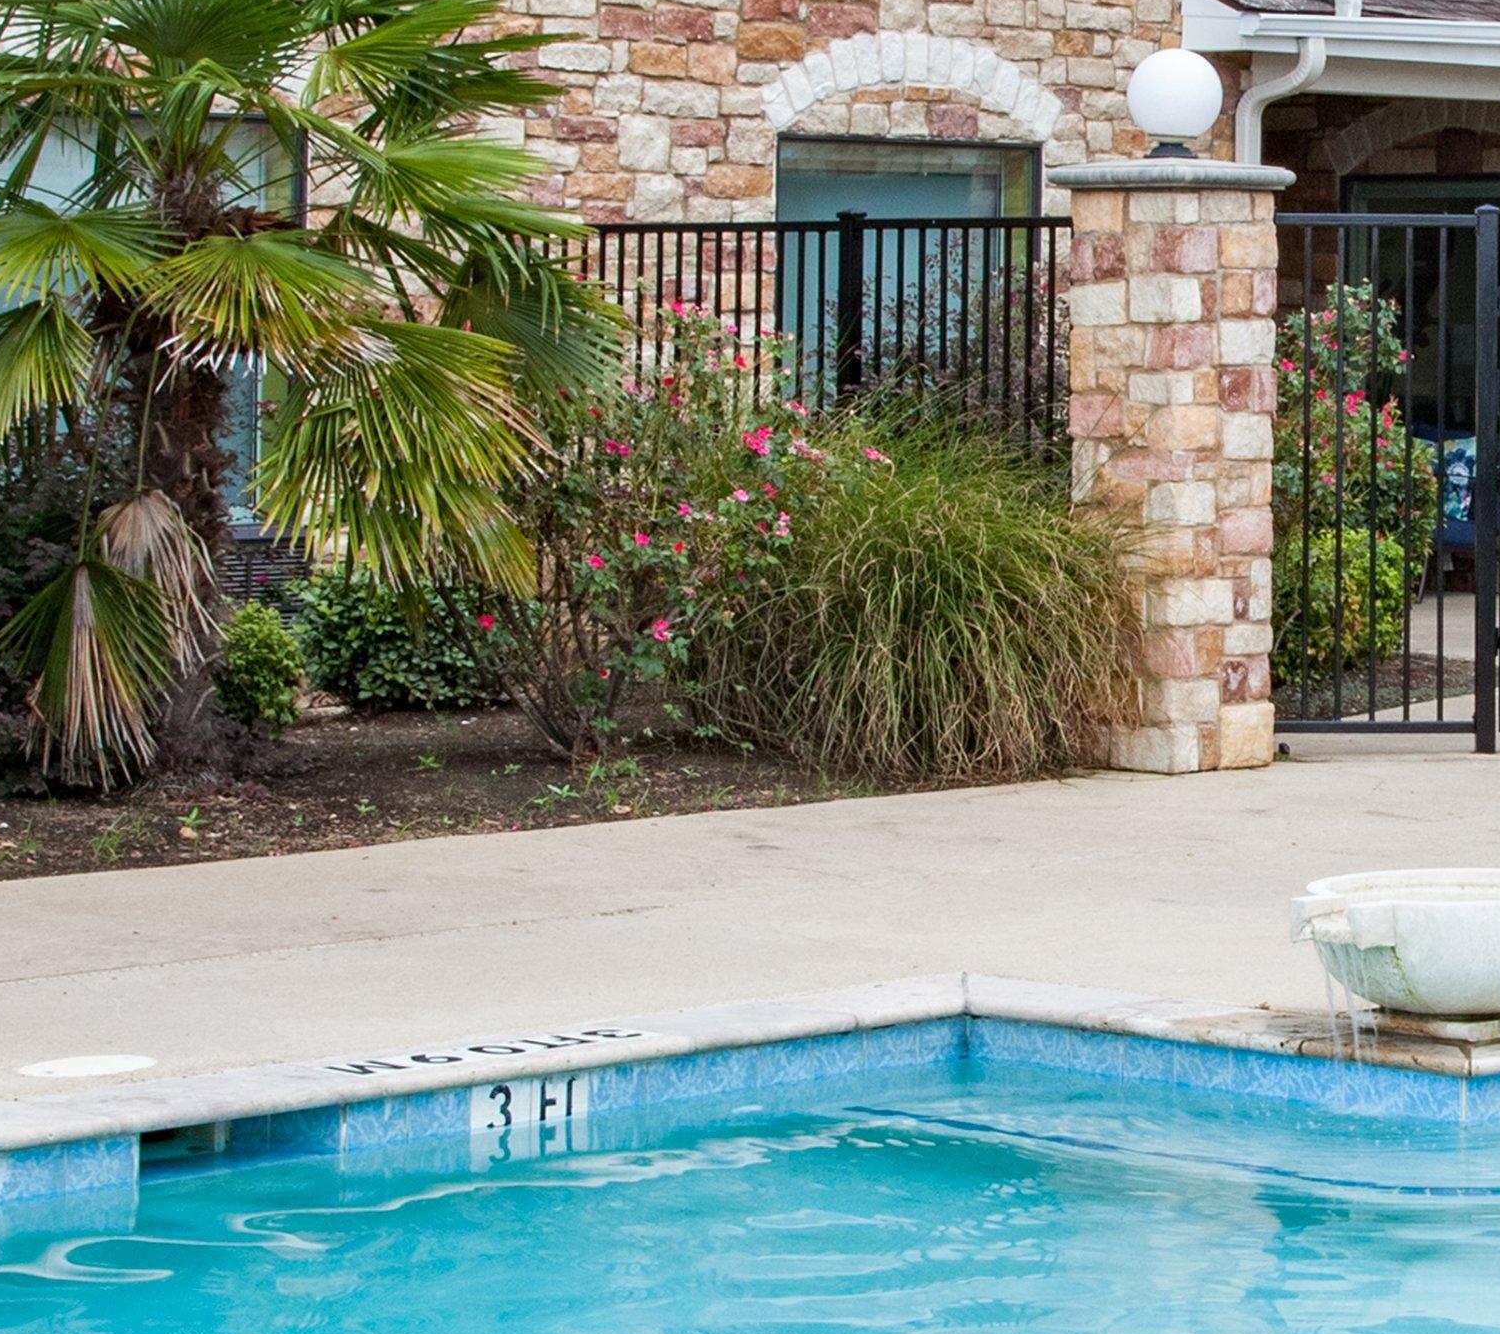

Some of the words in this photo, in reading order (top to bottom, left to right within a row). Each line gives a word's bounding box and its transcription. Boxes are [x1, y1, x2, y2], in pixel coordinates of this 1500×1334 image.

[581, 1029, 643, 1039] 3
[325, 1060, 409, 1075] M
[487, 1085, 512, 1129] 3
